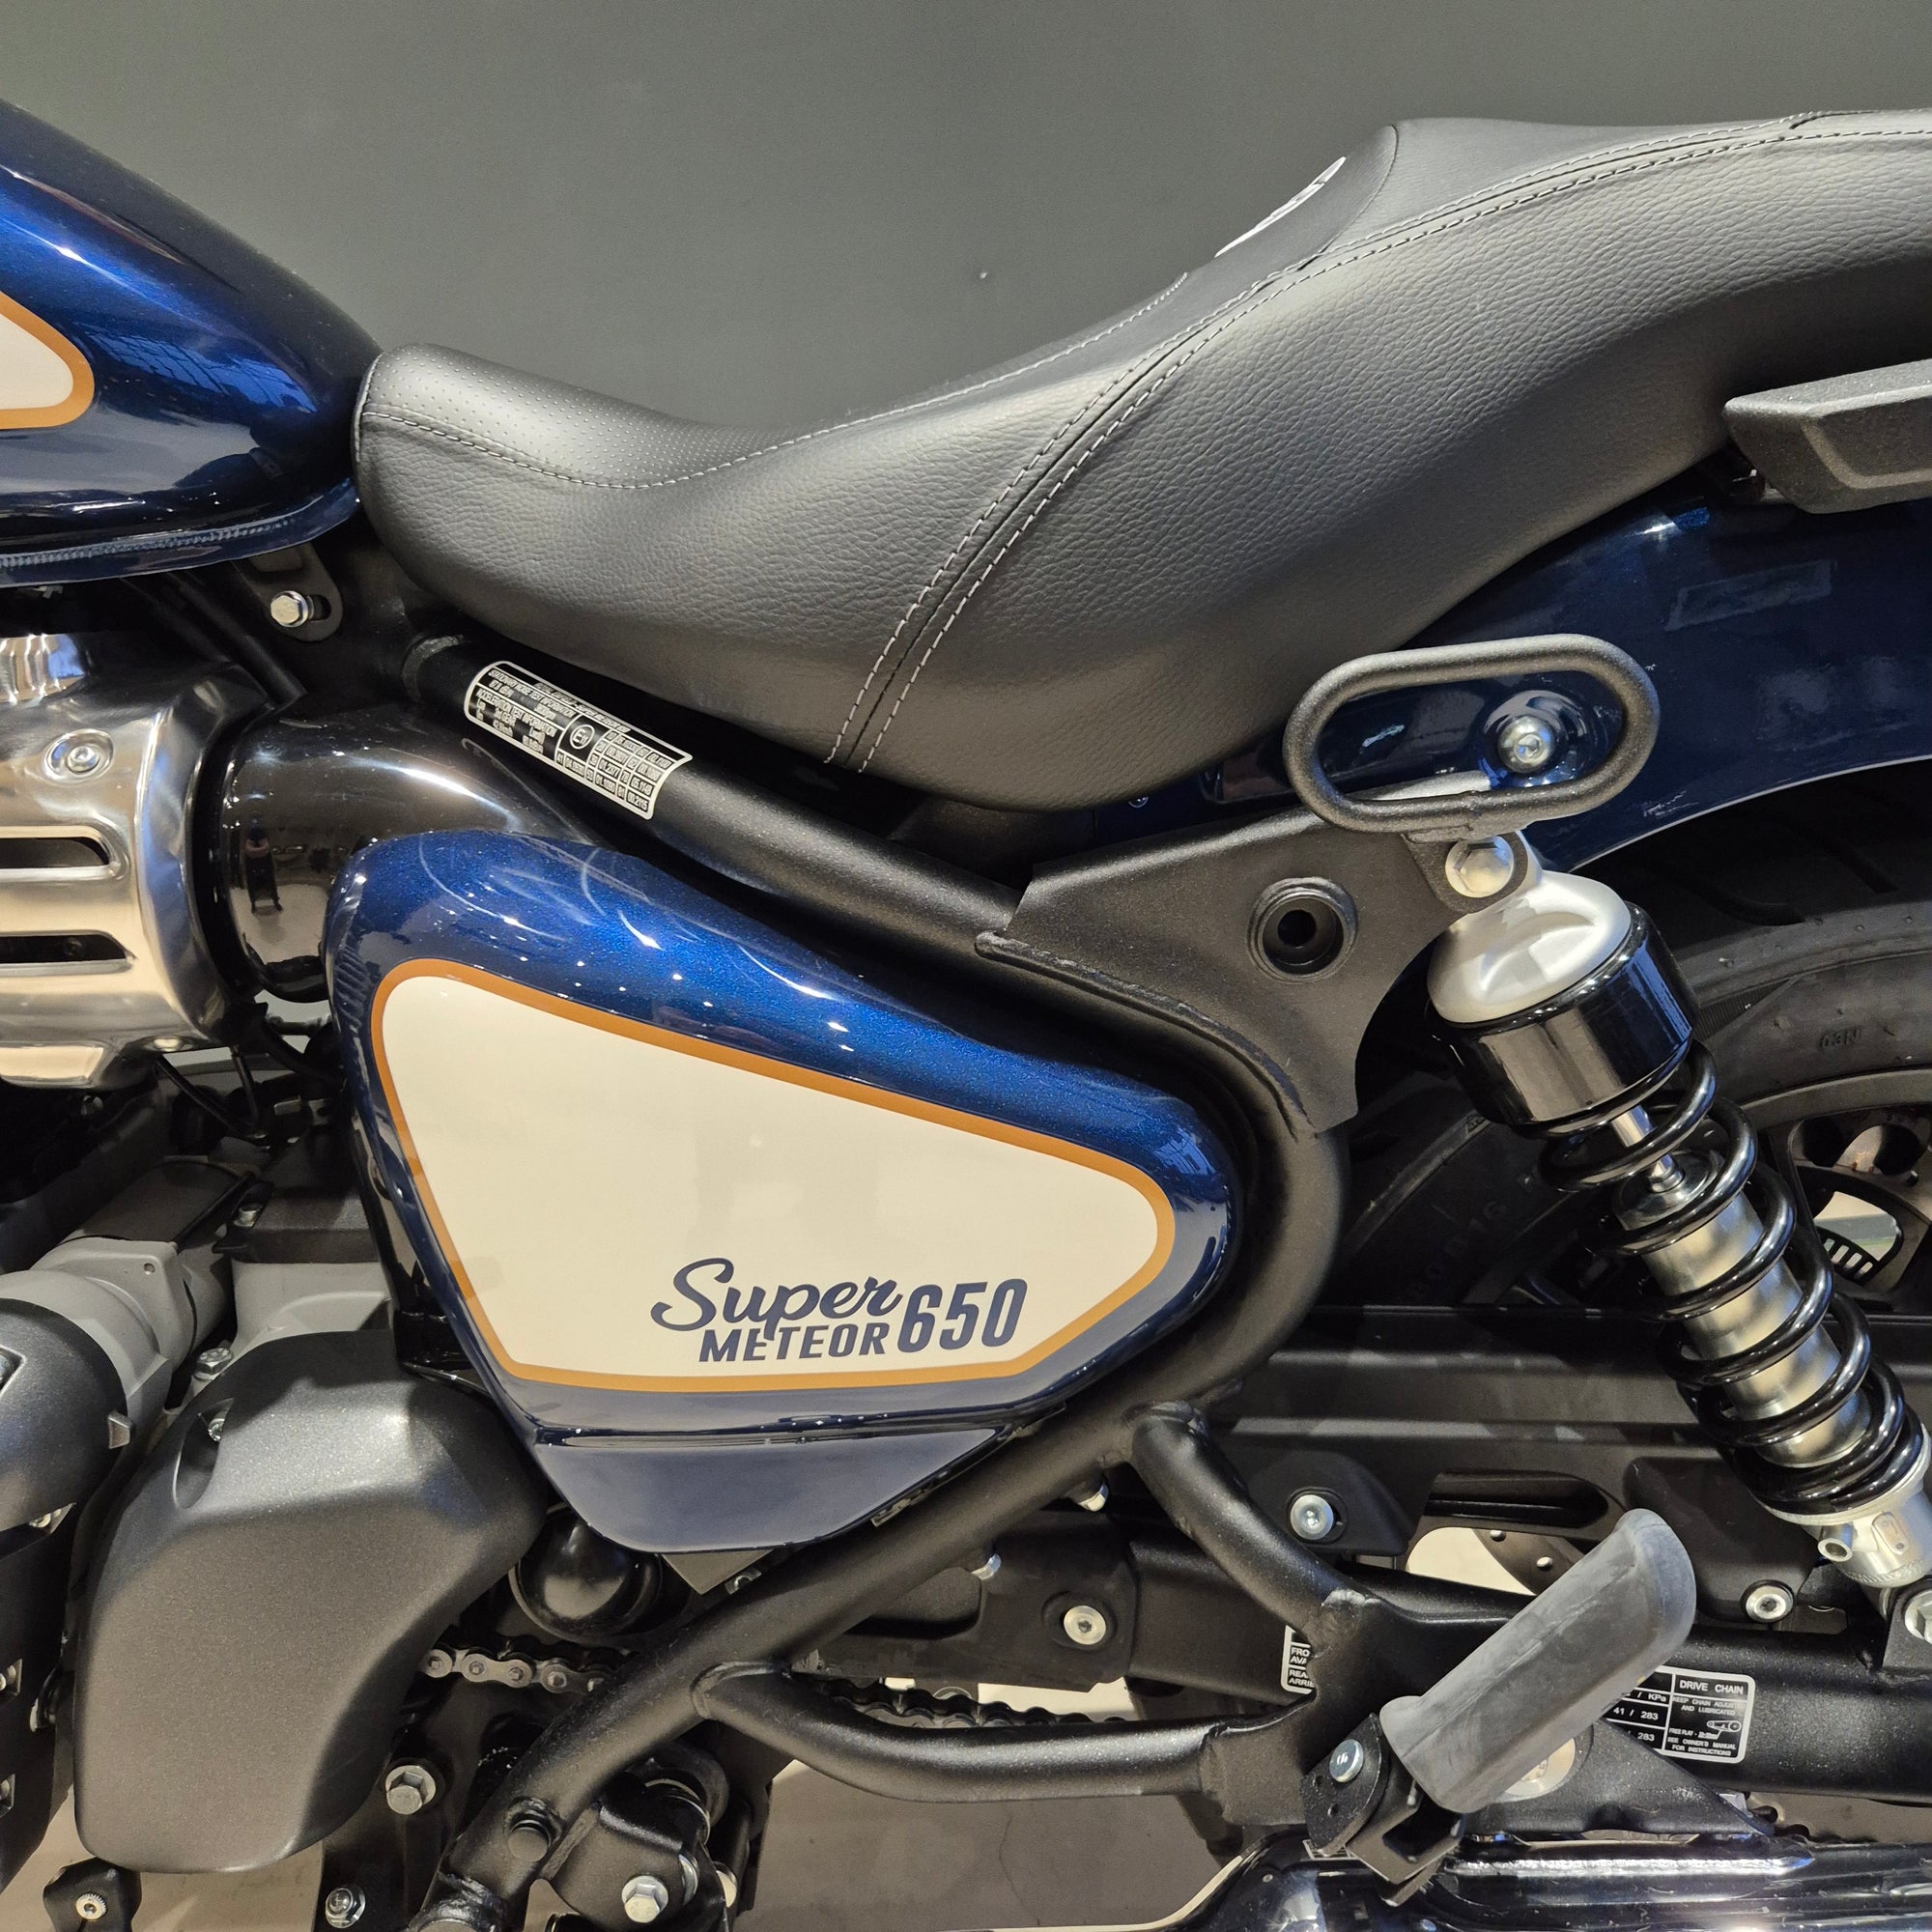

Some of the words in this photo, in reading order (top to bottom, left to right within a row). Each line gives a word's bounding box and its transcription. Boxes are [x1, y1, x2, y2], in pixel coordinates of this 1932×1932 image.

[649, 1257, 904, 1342] Super
[896, 1276, 1029, 1354] 650
[697, 1321, 891, 1363] METEOR
[1292, 1647, 1310, 1657] FRO
[1290, 1669, 1308, 1679] REA
[1289, 1678, 1316, 1688] ARRIE
[1679, 1679, 1708, 1690] DRIVE
[1714, 1683, 1744, 1694] CHAIN
[1647, 1692, 1666, 1701] KPa
[1612, 1706, 1624, 1715] 41
[1640, 1711, 1659, 1719] 283
[1698, 1706, 1735, 1717] LUBRICATED
[1636, 1732, 1655, 1741] 283
[1682, 1738, 1709, 1747] OWNER'S
[1688, 1746, 1731, 1756] INSTRUCTIONS
